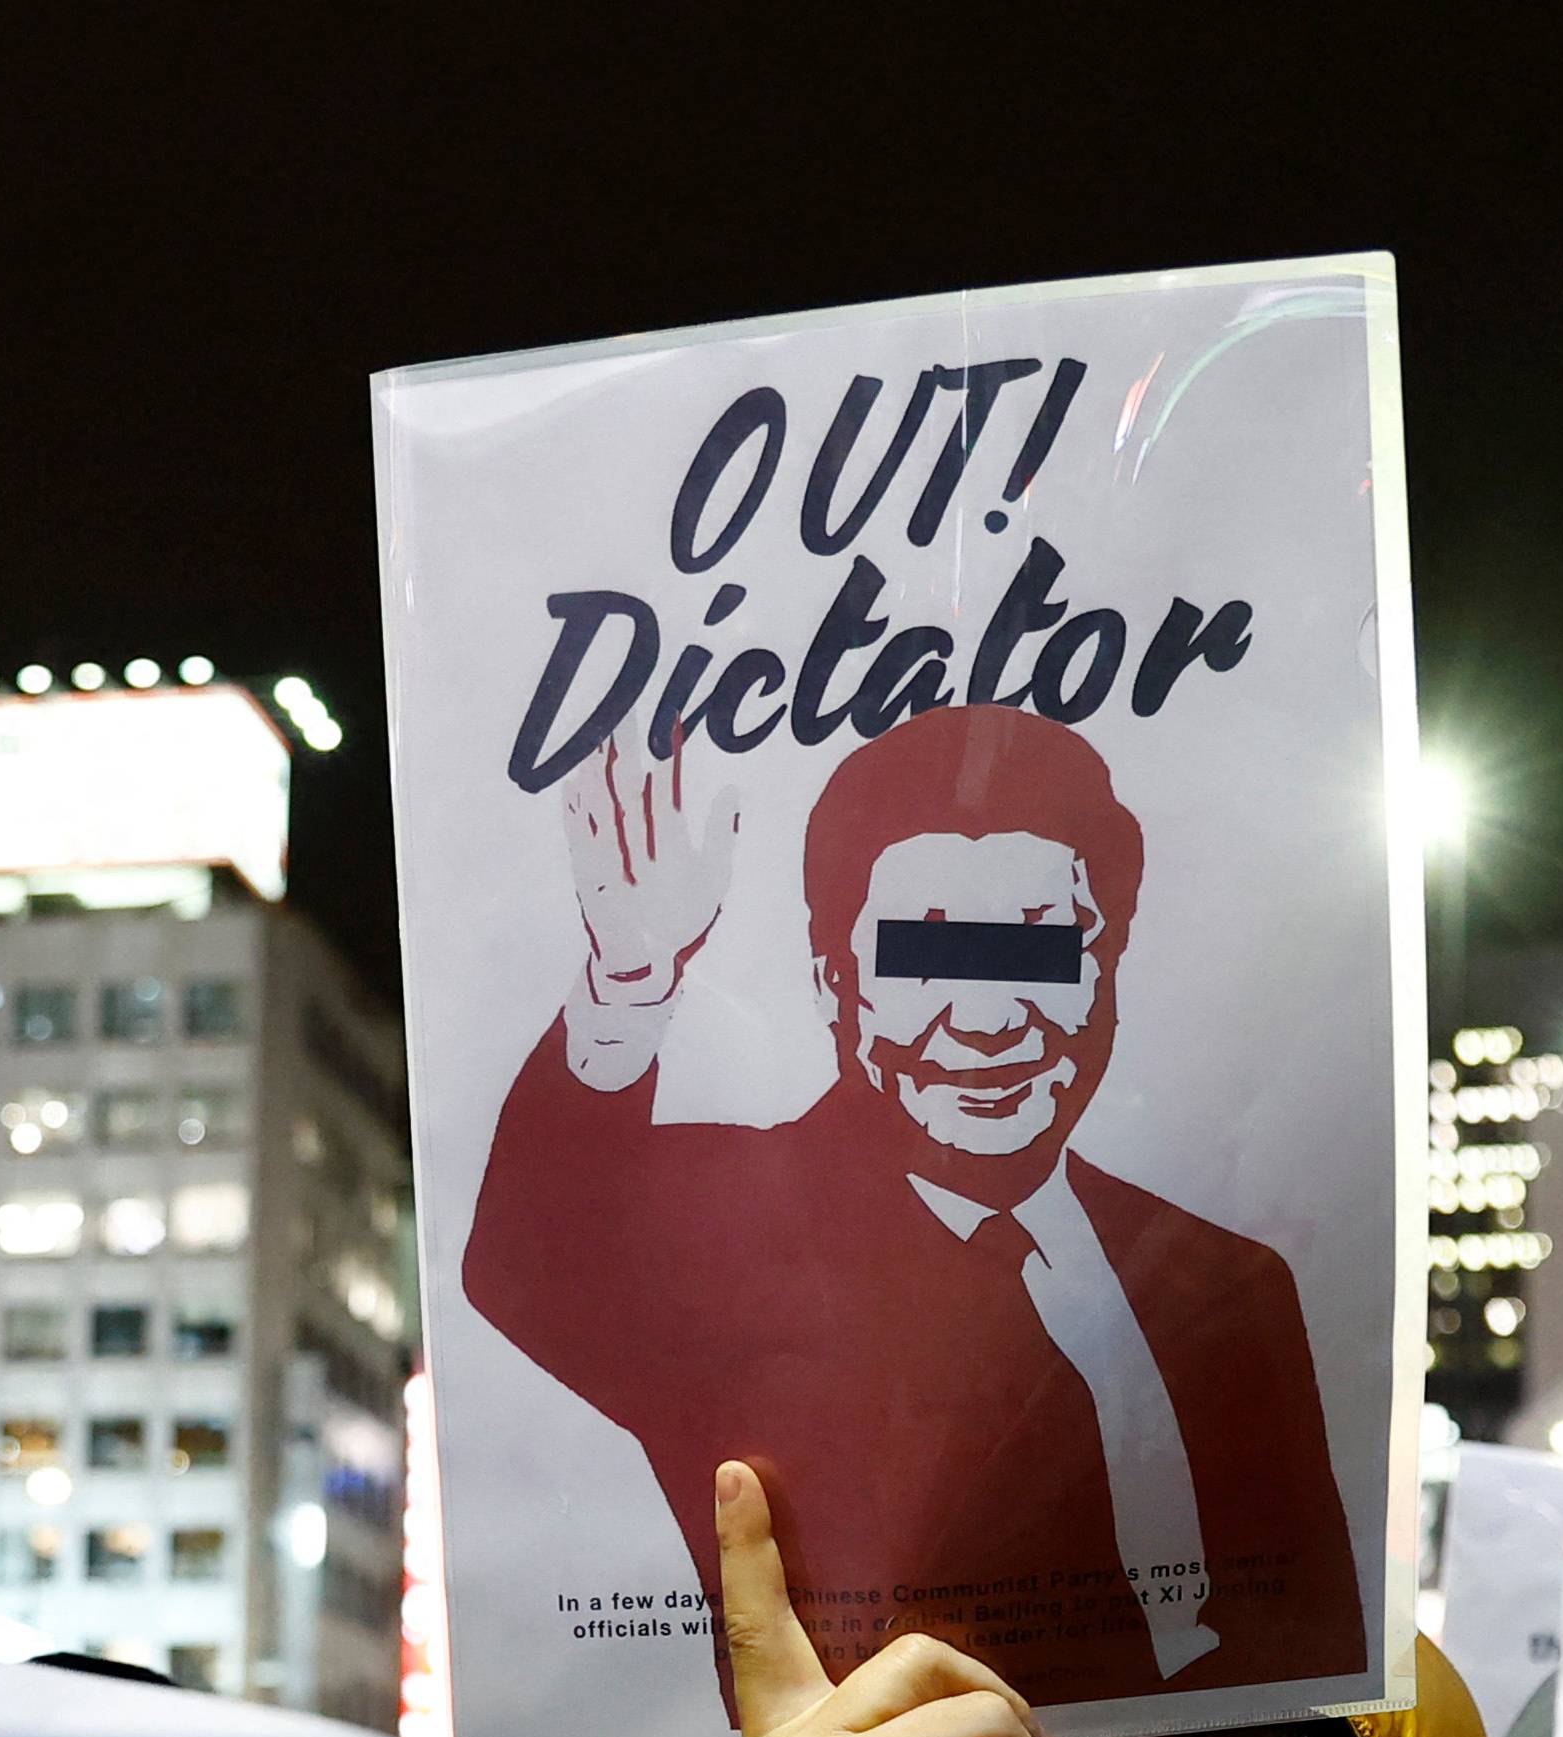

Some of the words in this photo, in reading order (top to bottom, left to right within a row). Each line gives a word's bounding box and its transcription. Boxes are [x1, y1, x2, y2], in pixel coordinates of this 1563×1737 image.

[670, 357, 1088, 576] OUT!
[507, 536, 1252, 793] Dictator
[557, 1593, 580, 1612] In
[588, 1597, 603, 1612] a
[610, 1591, 655, 1611] few
[788, 1586, 881, 1605] Chinese
[893, 1574, 1038, 1604] Communist
[1149, 1557, 1210, 1580] most
[572, 1618, 673, 1639] officials
[681, 1615, 726, 1636] will
[842, 1614, 862, 1632] in
[873, 1607, 964, 1633] central
[974, 1598, 1064, 1623] Beijing
[1075, 1592, 1098, 1611] to
[1110, 1586, 1149, 1611] put
[1159, 1584, 1183, 1604] Xi
[1192, 1576, 1286, 1602] Jinping
[823, 1642, 845, 1660] to
[965, 1626, 1047, 1649] leader
[1054, 1622, 1091, 1643] for
